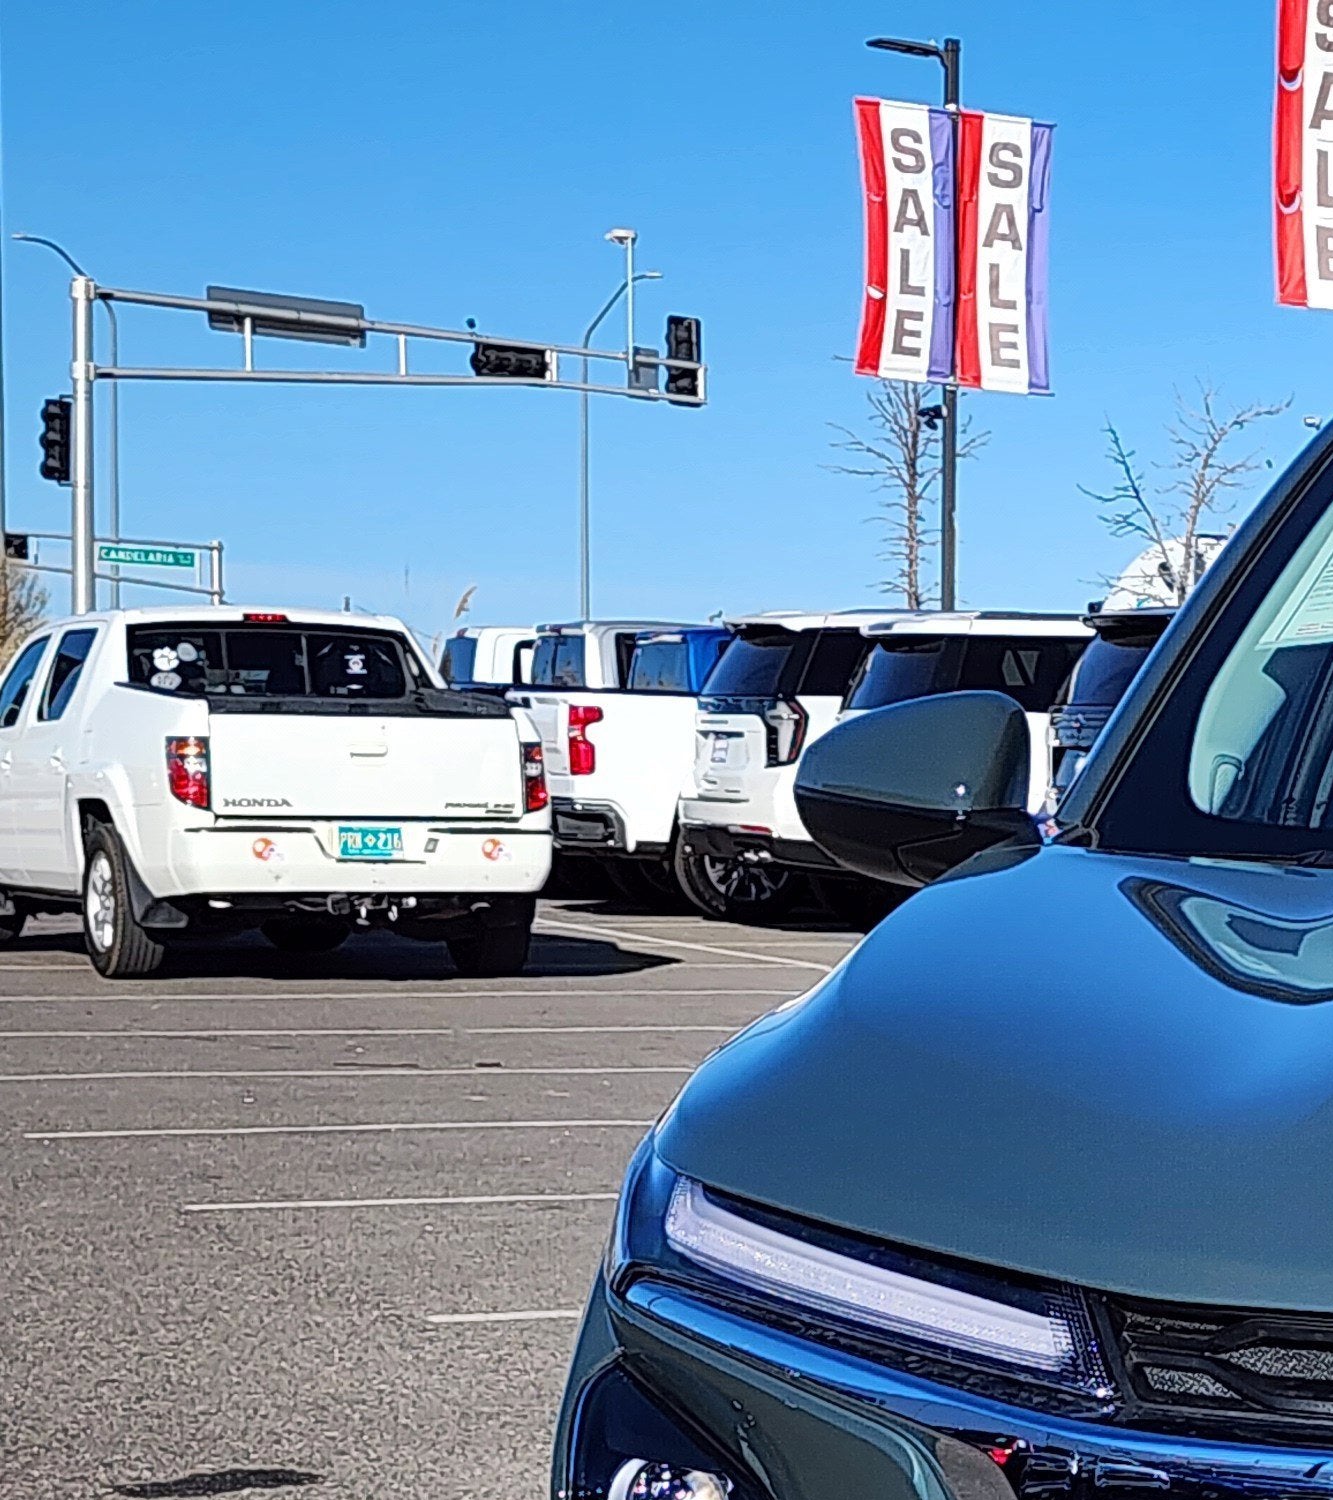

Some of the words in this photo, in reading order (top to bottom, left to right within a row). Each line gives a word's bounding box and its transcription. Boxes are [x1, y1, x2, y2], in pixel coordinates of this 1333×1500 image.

[890, 127, 931, 357] SALE
[982, 141, 1024, 369] SALE
[100, 547, 175, 564] CANDELARIA
[222, 797, 294, 808] HONDA
